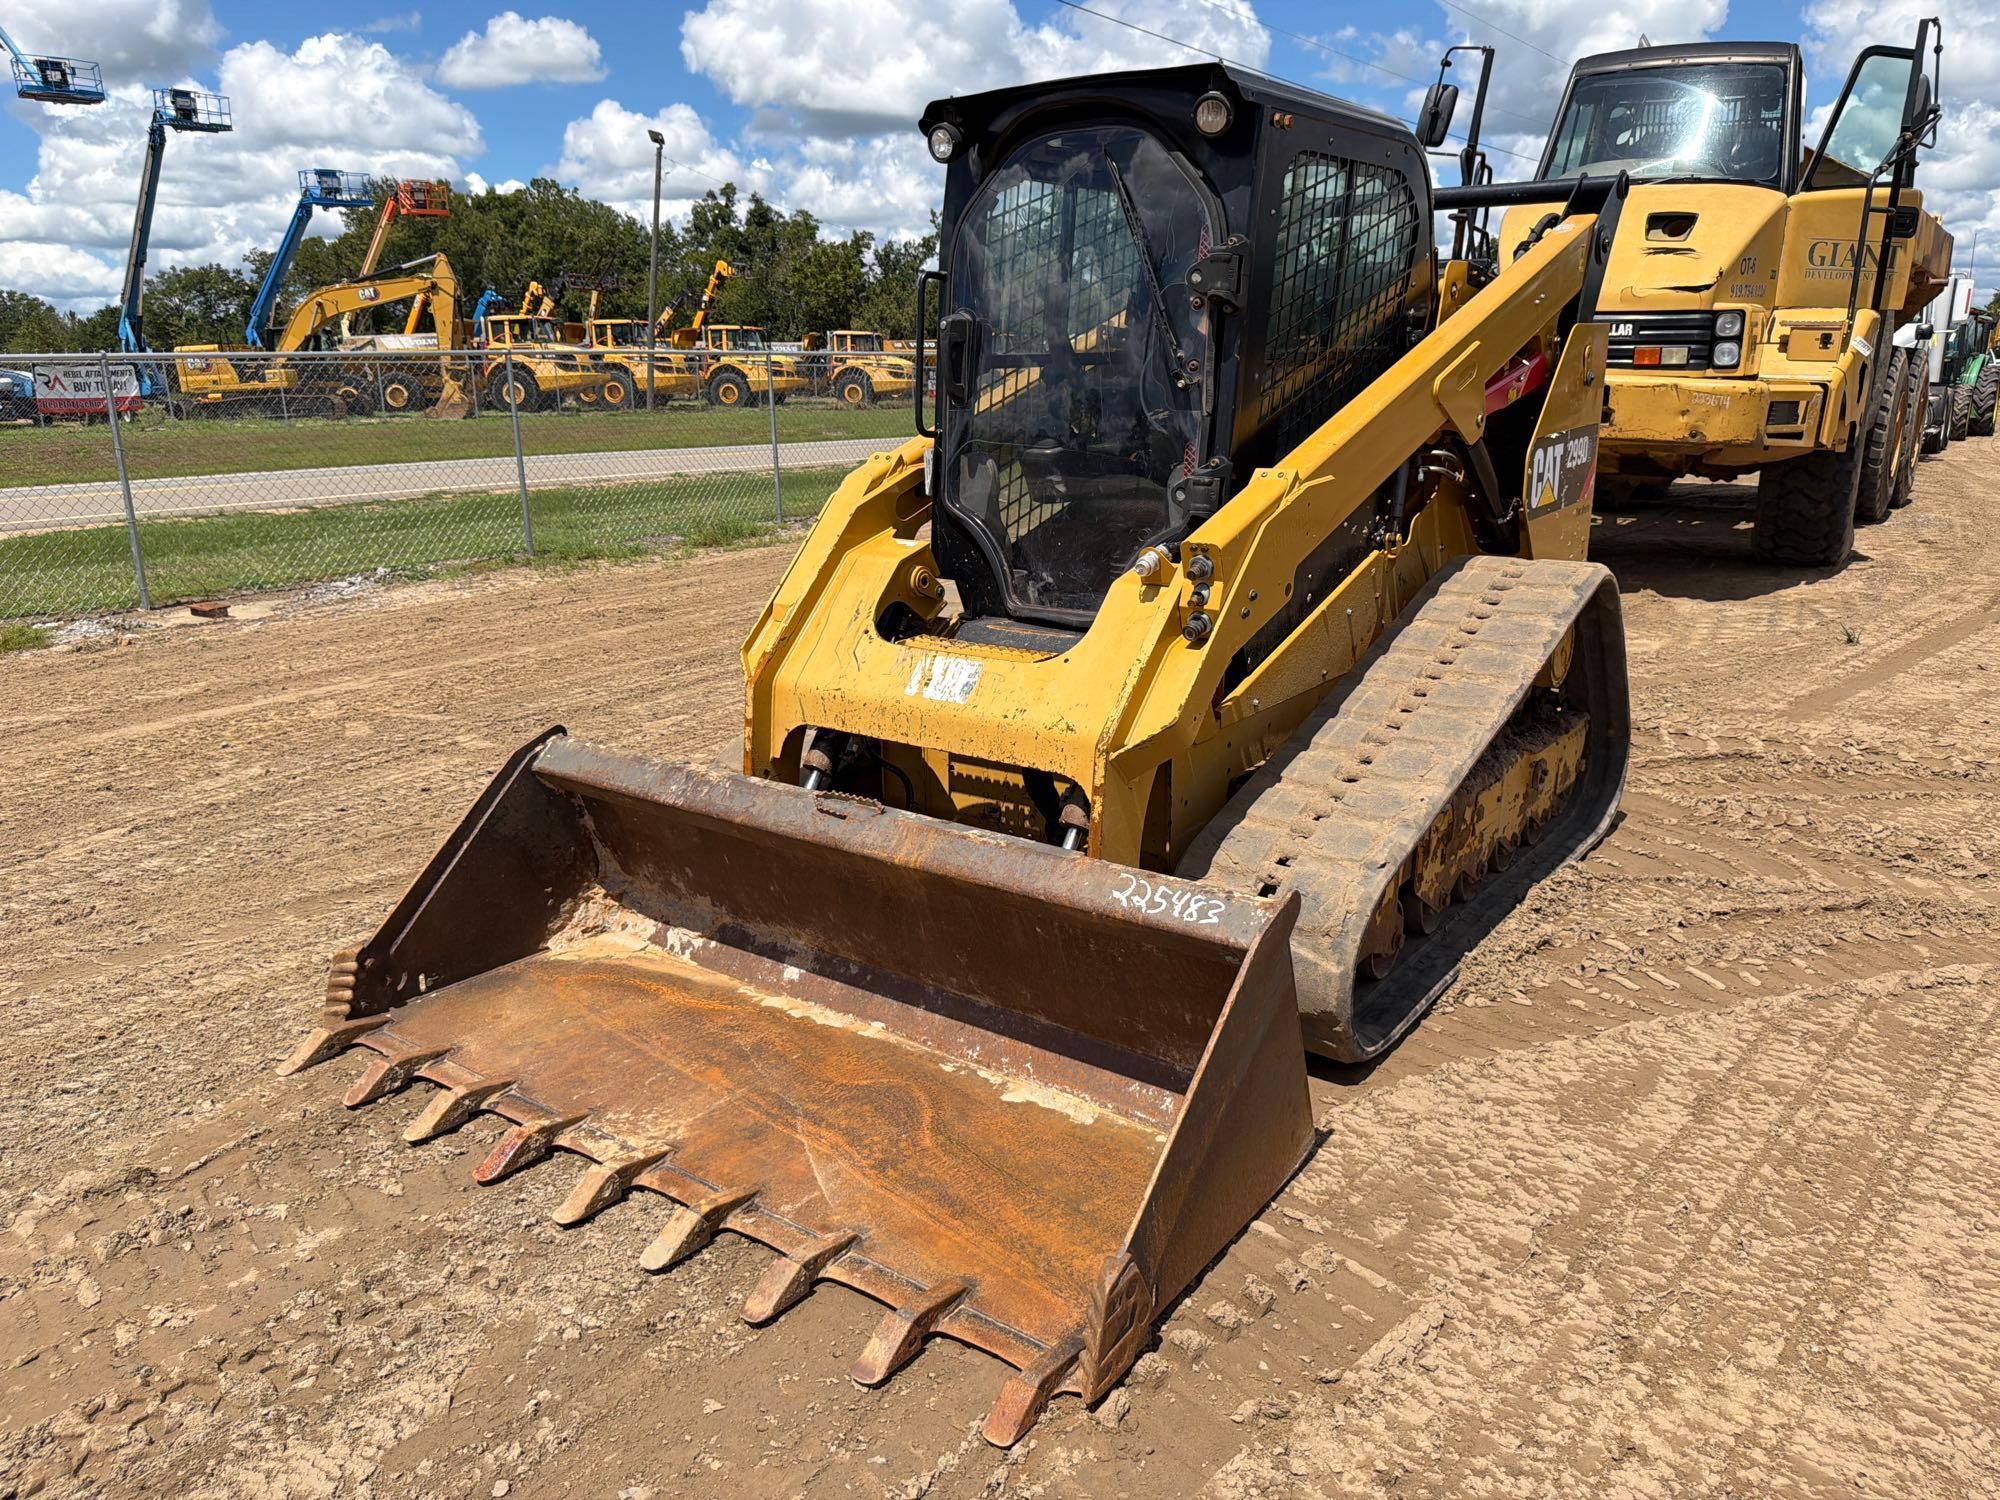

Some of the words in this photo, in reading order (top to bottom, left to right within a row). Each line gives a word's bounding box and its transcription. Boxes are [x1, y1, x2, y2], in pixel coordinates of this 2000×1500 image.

[1807, 240, 1903, 269] GIANT
[1804, 270, 1876, 281] DEVELOPMNT
[358, 286, 376, 301] CAT
[63, 370, 83, 379] REBEL
[85, 369, 133, 378] ATTAMENTS
[73, 381, 92, 392] BUY
[94, 380, 127, 391] TOAY!
[1531, 443, 1564, 508] CAT
[1566, 436, 1589, 469] 299D
[1110, 872, 1226, 925] 225483
